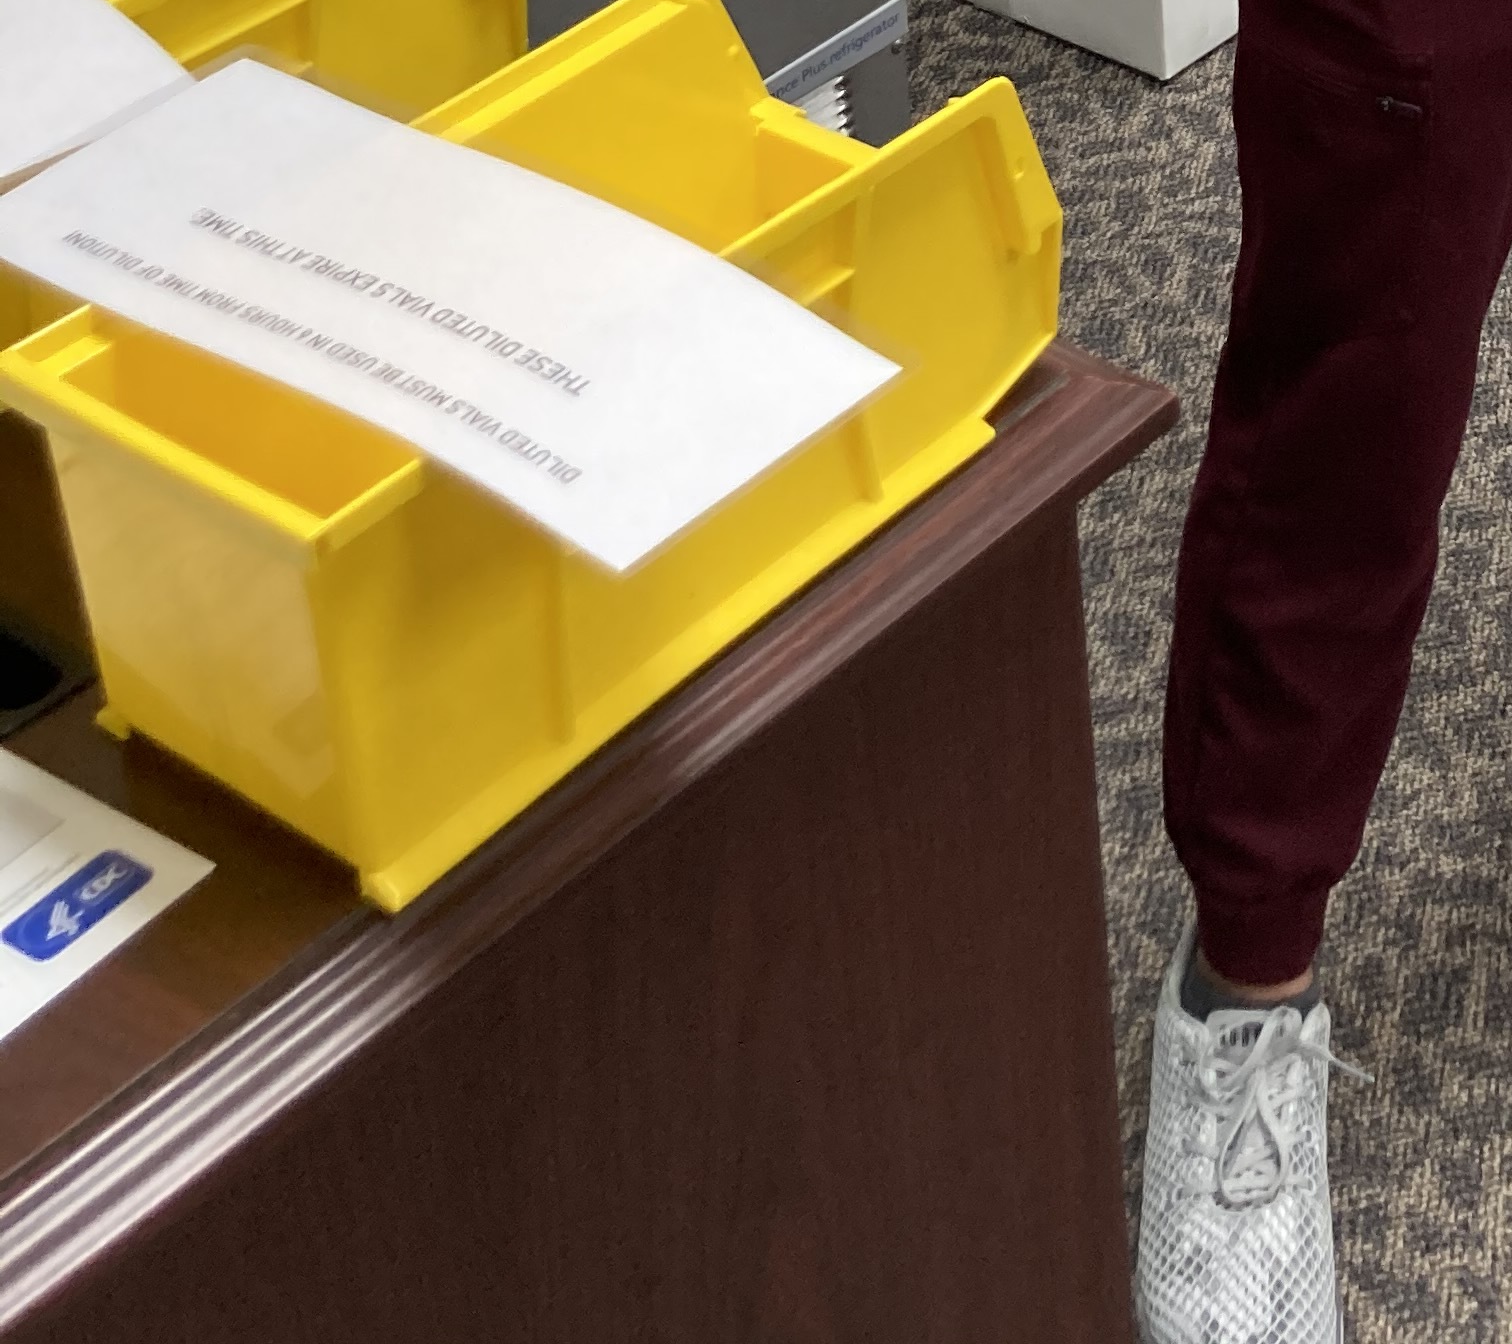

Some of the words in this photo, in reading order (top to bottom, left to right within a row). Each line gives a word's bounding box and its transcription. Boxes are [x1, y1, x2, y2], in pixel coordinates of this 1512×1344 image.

[801, 59, 827, 82] Plus
[829, 13, 900, 65] refrigerator
[234, 229, 286, 258] THIS
[276, 242, 313, 265] AT
[133, 264, 165, 282] OF
[154, 272, 200, 299] TIME
[300, 254, 381, 292] EXPIRE
[191, 286, 249, 316] FROM
[370, 281, 436, 318] VIALS
[237, 305, 303, 338] HOURS
[428, 307, 525, 359] DILUTED
[305, 333, 334, 351] IN
[326, 341, 380, 372] USED
[513, 348, 592, 397] THESE
[400, 374, 453, 409] MUST
[444, 398, 503, 436] VIALS
[498, 429, 583, 485] DILUTED
